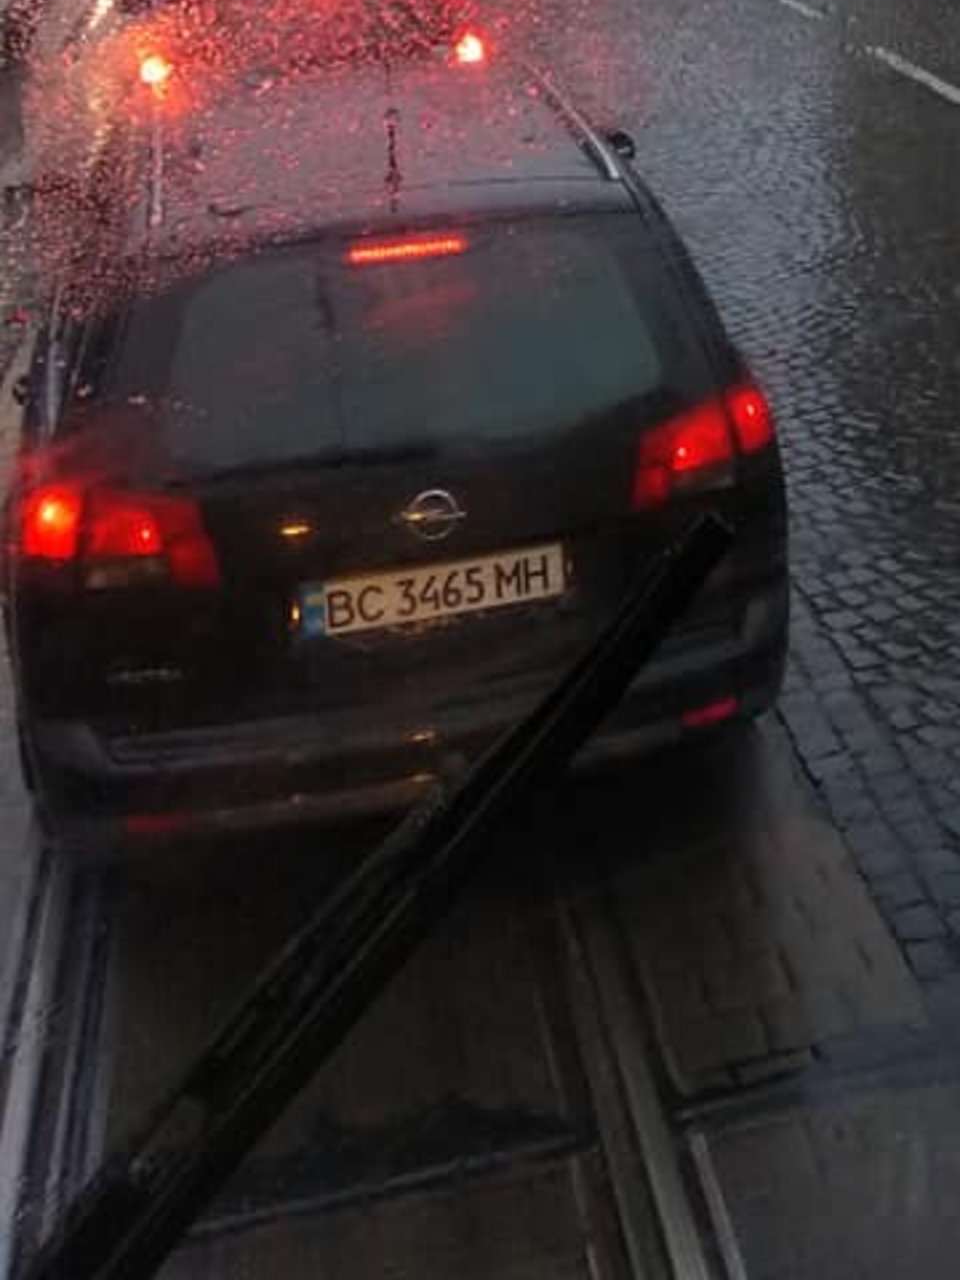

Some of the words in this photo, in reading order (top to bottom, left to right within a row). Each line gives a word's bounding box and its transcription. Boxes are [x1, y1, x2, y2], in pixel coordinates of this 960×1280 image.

[326, 585, 385, 628] BC
[396, 566, 485, 617] 3465
[494, 554, 550, 599] MH
